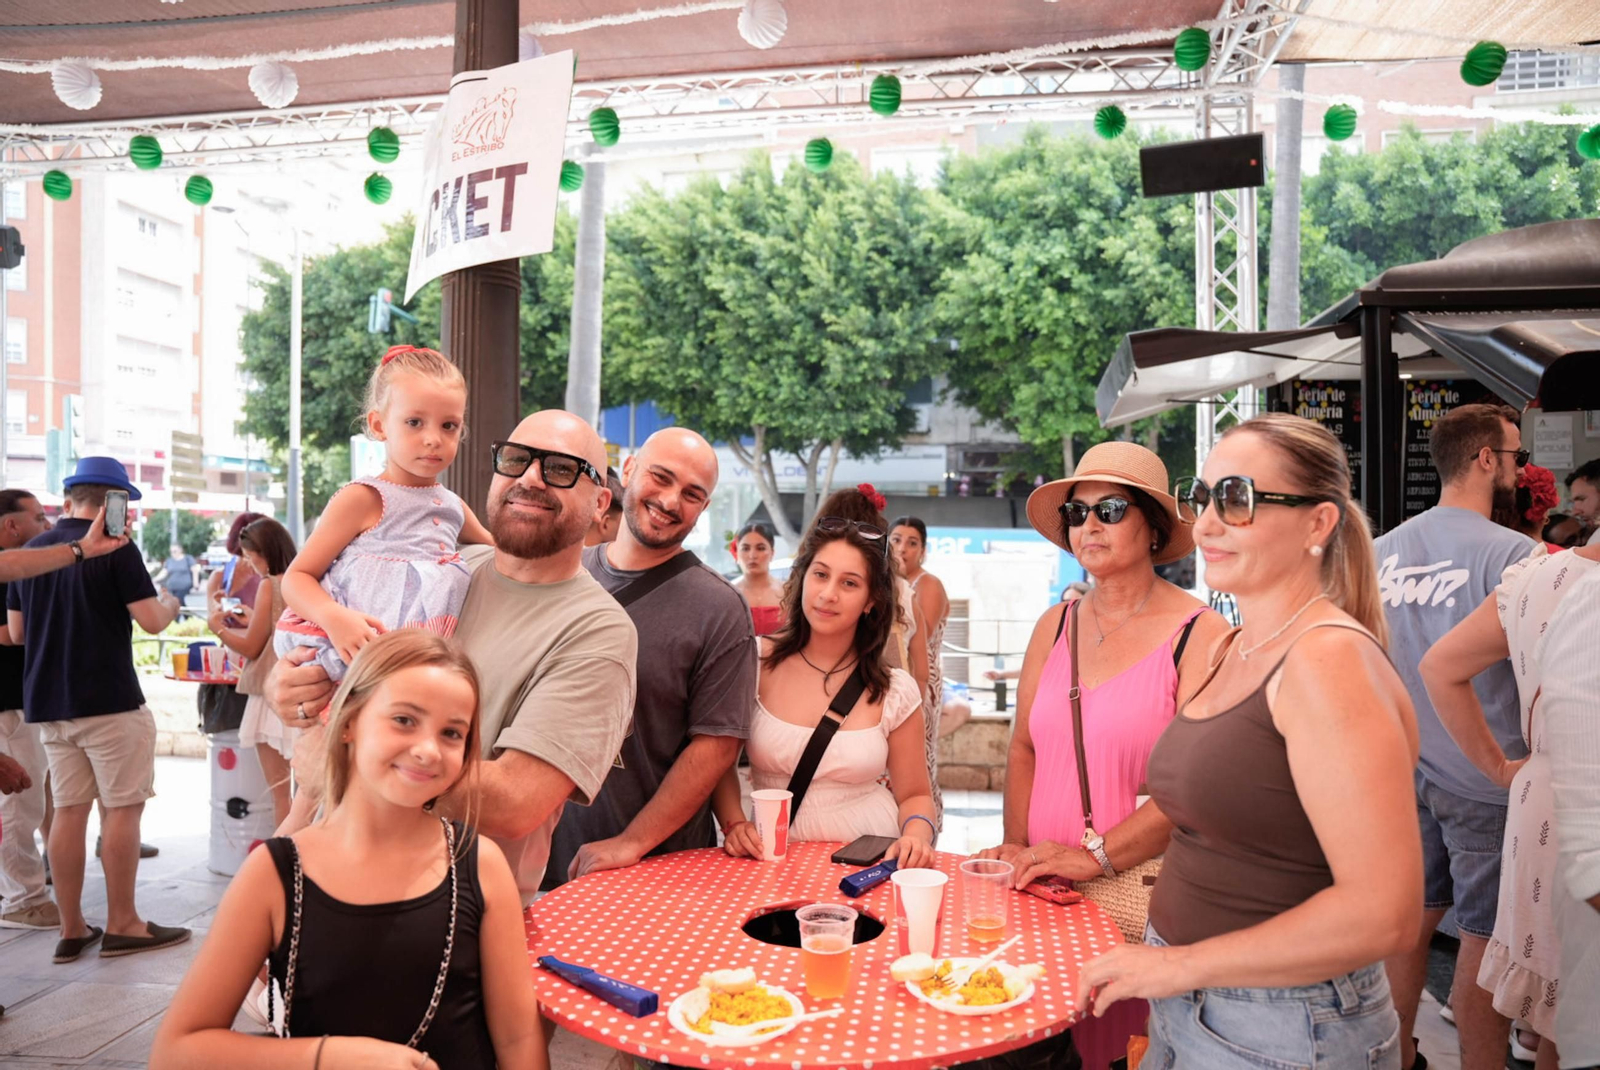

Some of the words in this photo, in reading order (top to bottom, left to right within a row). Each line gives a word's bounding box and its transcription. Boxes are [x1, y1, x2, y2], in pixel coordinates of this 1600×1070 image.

[452, 152, 462, 162] EL
[463, 142, 505, 158] ESTRIBO
[425, 162, 528, 257] CKET
[1298, 388, 1328, 402] Feria
[1331, 388, 1346, 402] de
[1411, 389, 1442, 404] Feria
[1444, 390, 1460, 404] de
